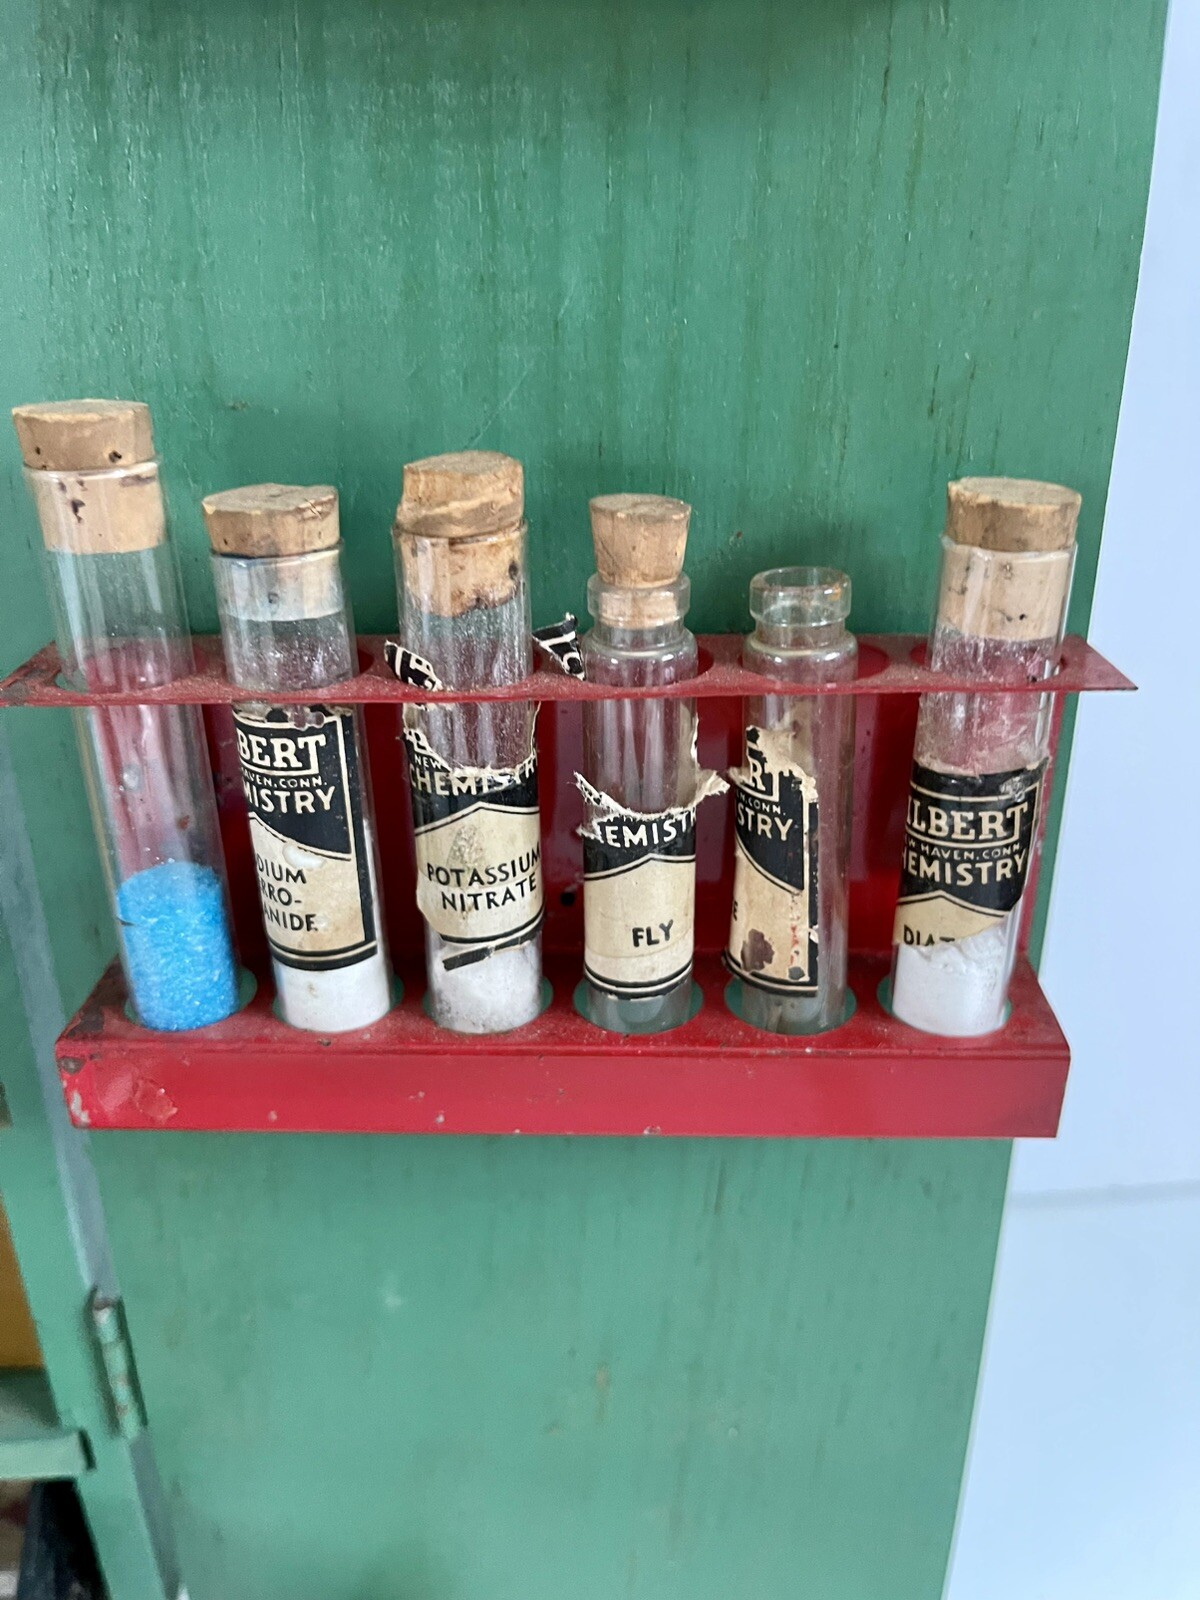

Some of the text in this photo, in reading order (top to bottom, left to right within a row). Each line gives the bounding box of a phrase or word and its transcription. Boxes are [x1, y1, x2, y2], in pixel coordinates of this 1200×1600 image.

[426, 840, 541, 887] POTASSIUM
[441, 871, 537, 912] NITRATE
[631, 918, 674, 948] FLY
